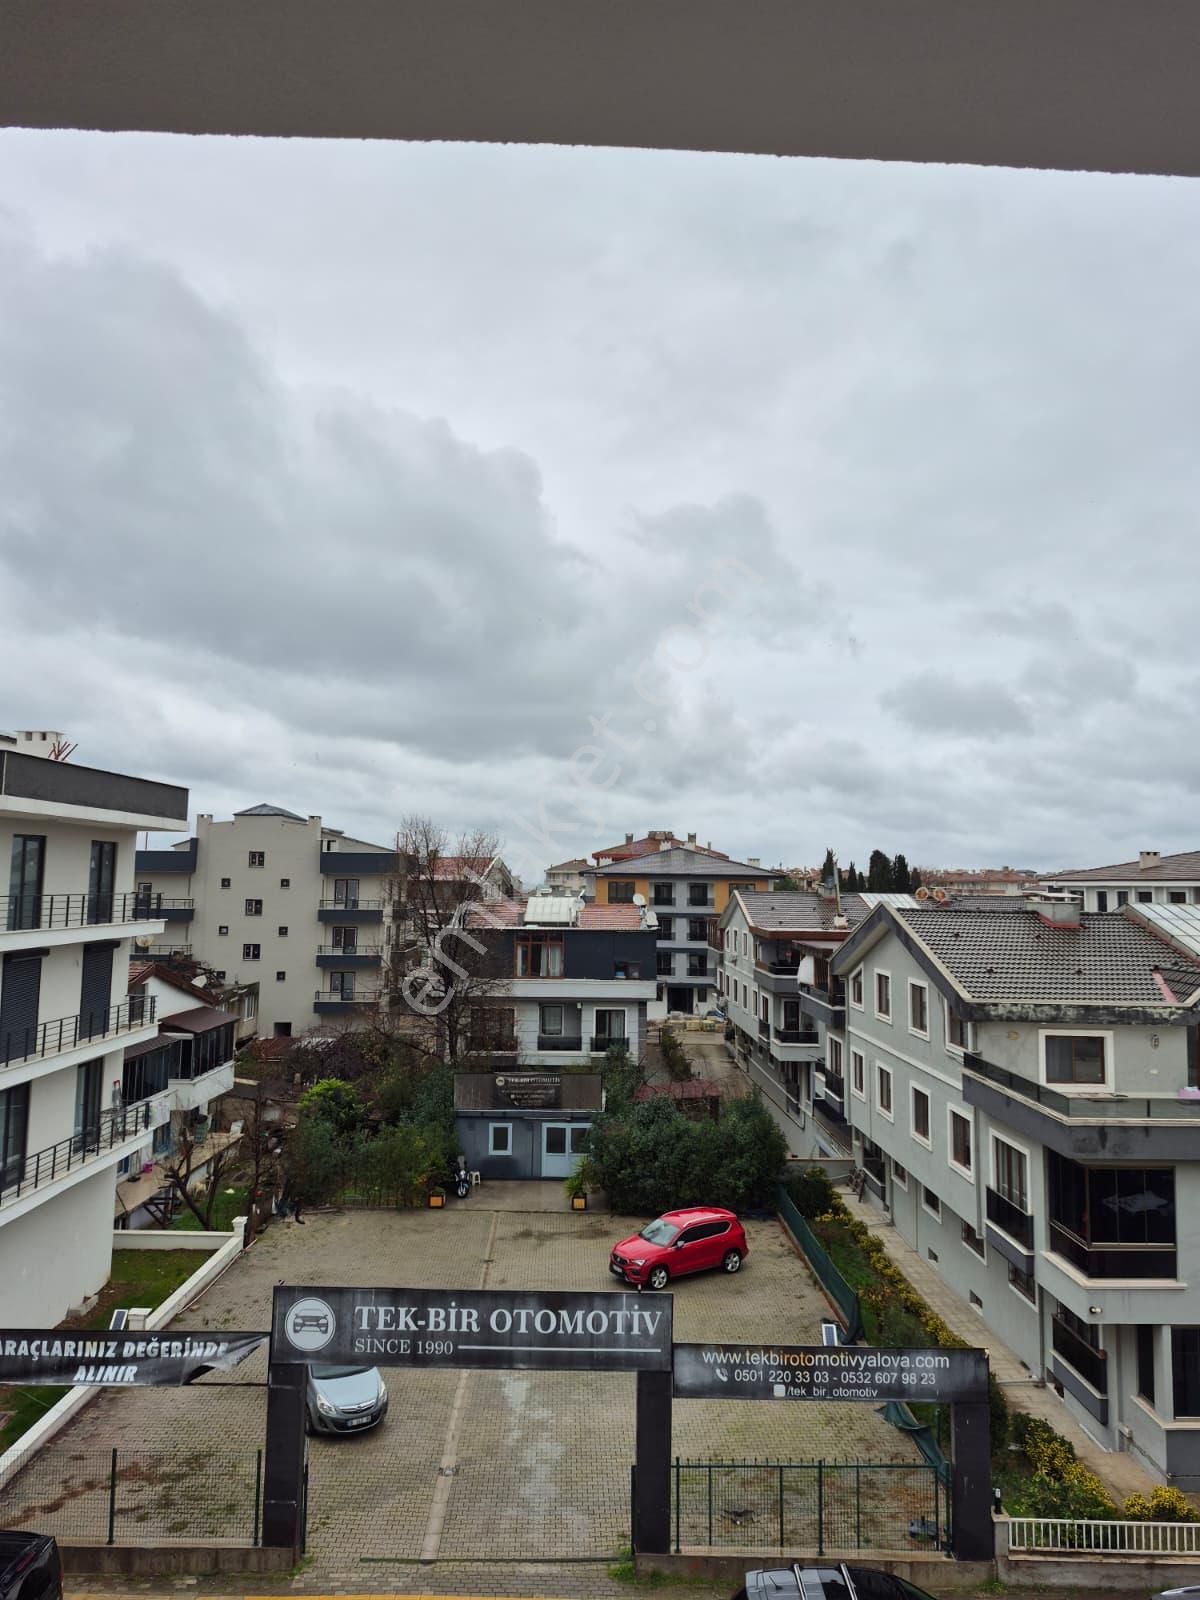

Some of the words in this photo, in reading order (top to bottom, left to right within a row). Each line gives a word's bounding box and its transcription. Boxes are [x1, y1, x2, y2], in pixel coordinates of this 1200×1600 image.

[354, 1301, 480, 1332] TEK-BİR
[489, 1304, 663, 1336] OTOMOTİV
[417, 1341, 454, 1355] 1990
[702, 1349, 950, 1371] www.tekbirotomotivyalova.com
[73, 1365, 138, 1382] ALINIR
[734, 1369, 764, 1382] 0501
[768, 1370, 791, 1383] 220
[795, 1371, 810, 1384] 33
[814, 1371, 829, 1384] 03
[840, 1372, 871, 1384] 0532
[874, 1372, 897, 1385] 607
[901, 1372, 917, 1385] 98
[920, 1373, 936, 1385] 23
